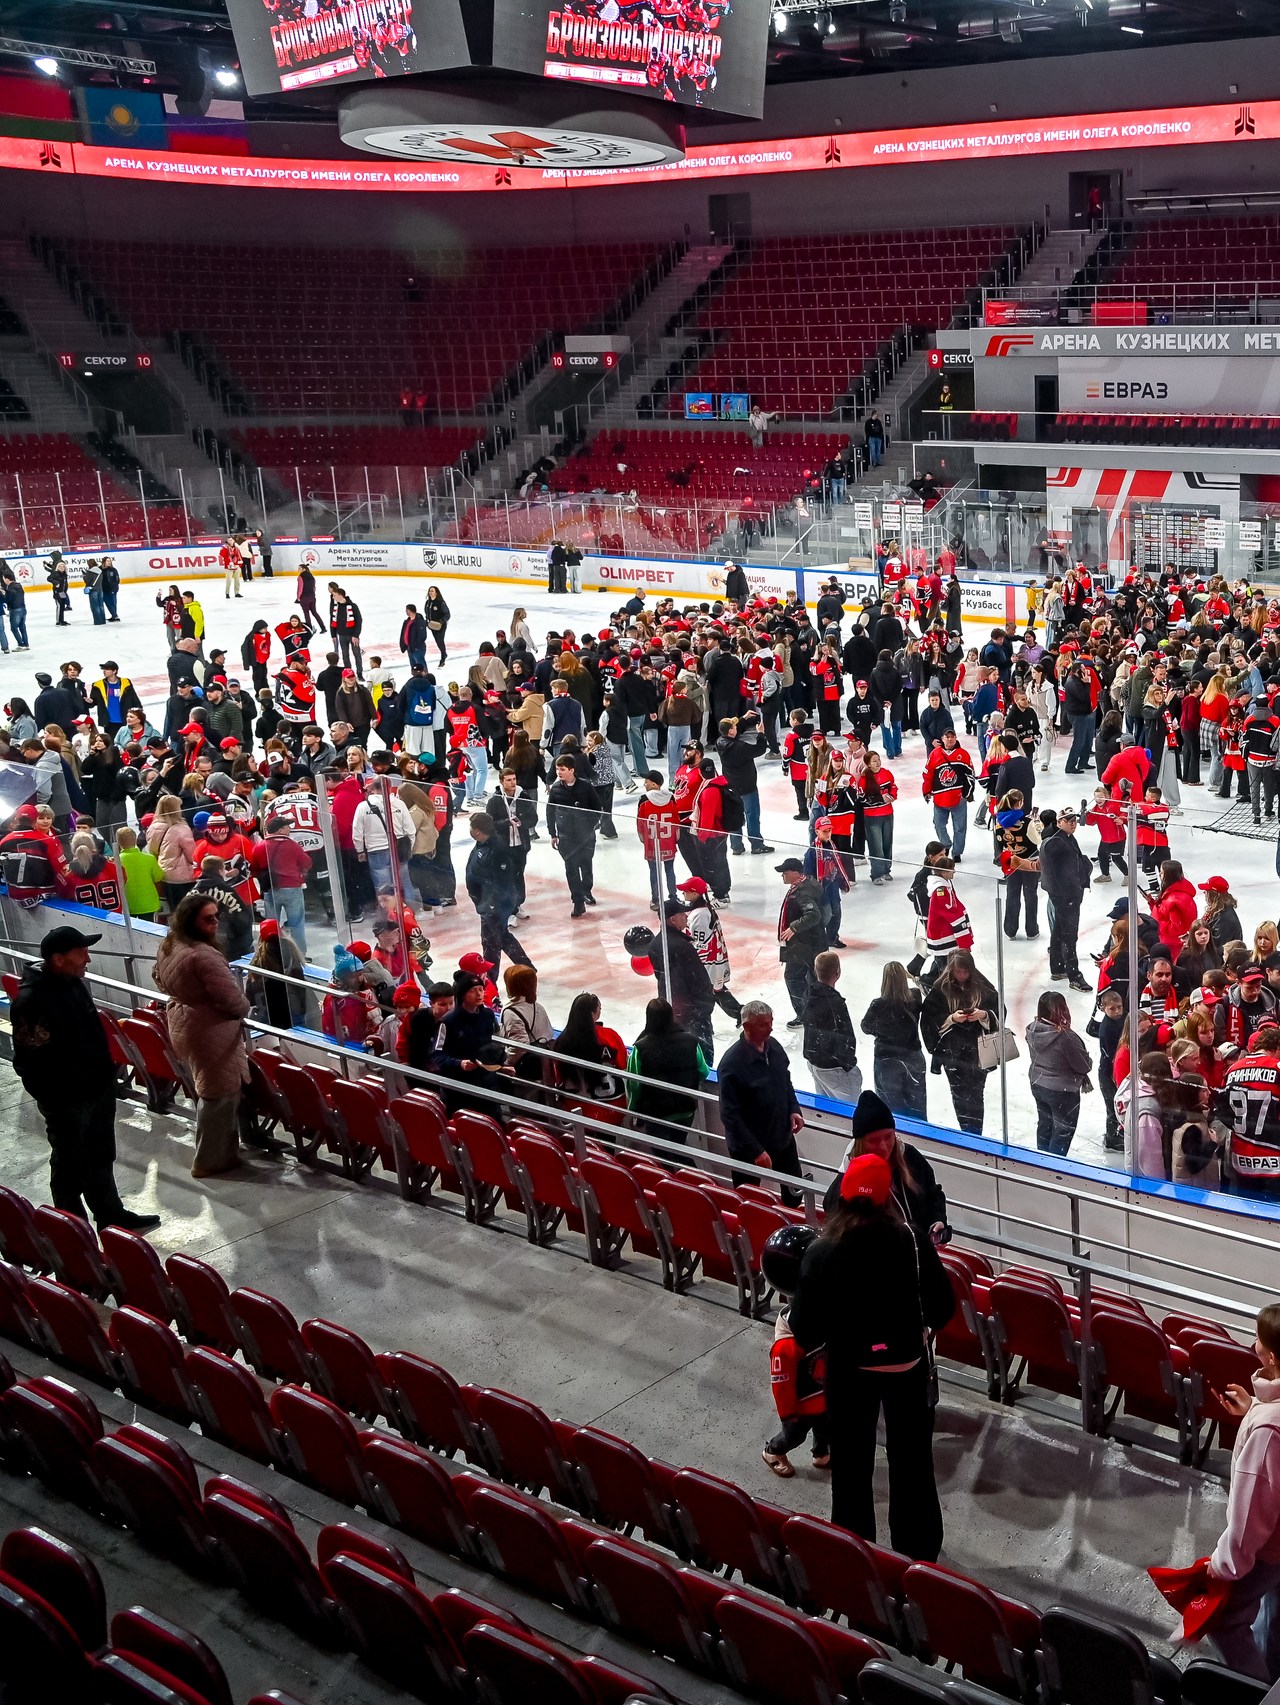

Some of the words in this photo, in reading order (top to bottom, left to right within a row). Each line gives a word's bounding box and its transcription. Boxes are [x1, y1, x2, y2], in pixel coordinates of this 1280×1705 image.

[873, 143, 905, 154] АРЕНА
[907, 138, 964, 151] КУЗНЕЦКИХ
[967, 132, 1041, 147] МЕТАЛЛУРГОВ
[1043, 129, 1080, 142] ИМЕНИ
[1082, 126, 1118, 139] ОЛЕГА
[1121, 122, 1191, 136] КОРОЛЕНКО
[105, 157, 144, 170] АРЕНА
[147, 161, 218, 175] КУЗНЕЦКИХ
[221, 166, 308, 180] МЕТАЛЛУРГОВ
[311, 171, 351, 181] ИМЕНИ
[354, 172, 391, 182] ОЛЕГА
[394, 173, 460, 182] КОРОЛЕНКО
[542, 168, 571, 178] АРЕНА
[678, 157, 707, 169] ИМЕНИ
[708, 155, 737, 166] ОЛЕГА
[738, 151, 792, 164] КОРОЛЕНКО
[1041, 333, 1100, 350] АРЕНА
[1116, 333, 1230, 352] КУЗНЕЦКИХ
[61, 355, 72, 366] 11
[85, 356, 127, 366] СЕКТОР
[138, 357, 151, 366] 10
[553, 356, 563, 366] 10
[569, 356, 598, 366] СЕКТОР
[606, 356, 613, 366] 9
[931, 353, 939, 365] 9
[943, 353, 974, 364] СЕКТО
[1104, 382, 1168, 399] ЕВРАЗ
[149, 554, 260, 569] OLIMPT
[440, 554, 482, 567] VHLRU.RU
[600, 566, 674, 583] OLIMPBET
[960, 588, 992, 598] овская
[966, 600, 1003, 610] Кузбасс
[433, 795, 445, 806] 51
[276, 803, 313, 828] 50
[297, 838, 320, 848] ВРАЗ
[75, 879, 122, 910] 99
[693, 930, 705, 942] 58
[1226, 1067, 1276, 1086] ВЧИННИКОВ
[1230, 1090, 1272, 1135] 97
[1238, 1156, 1279, 1169] ЕВРАЗ
